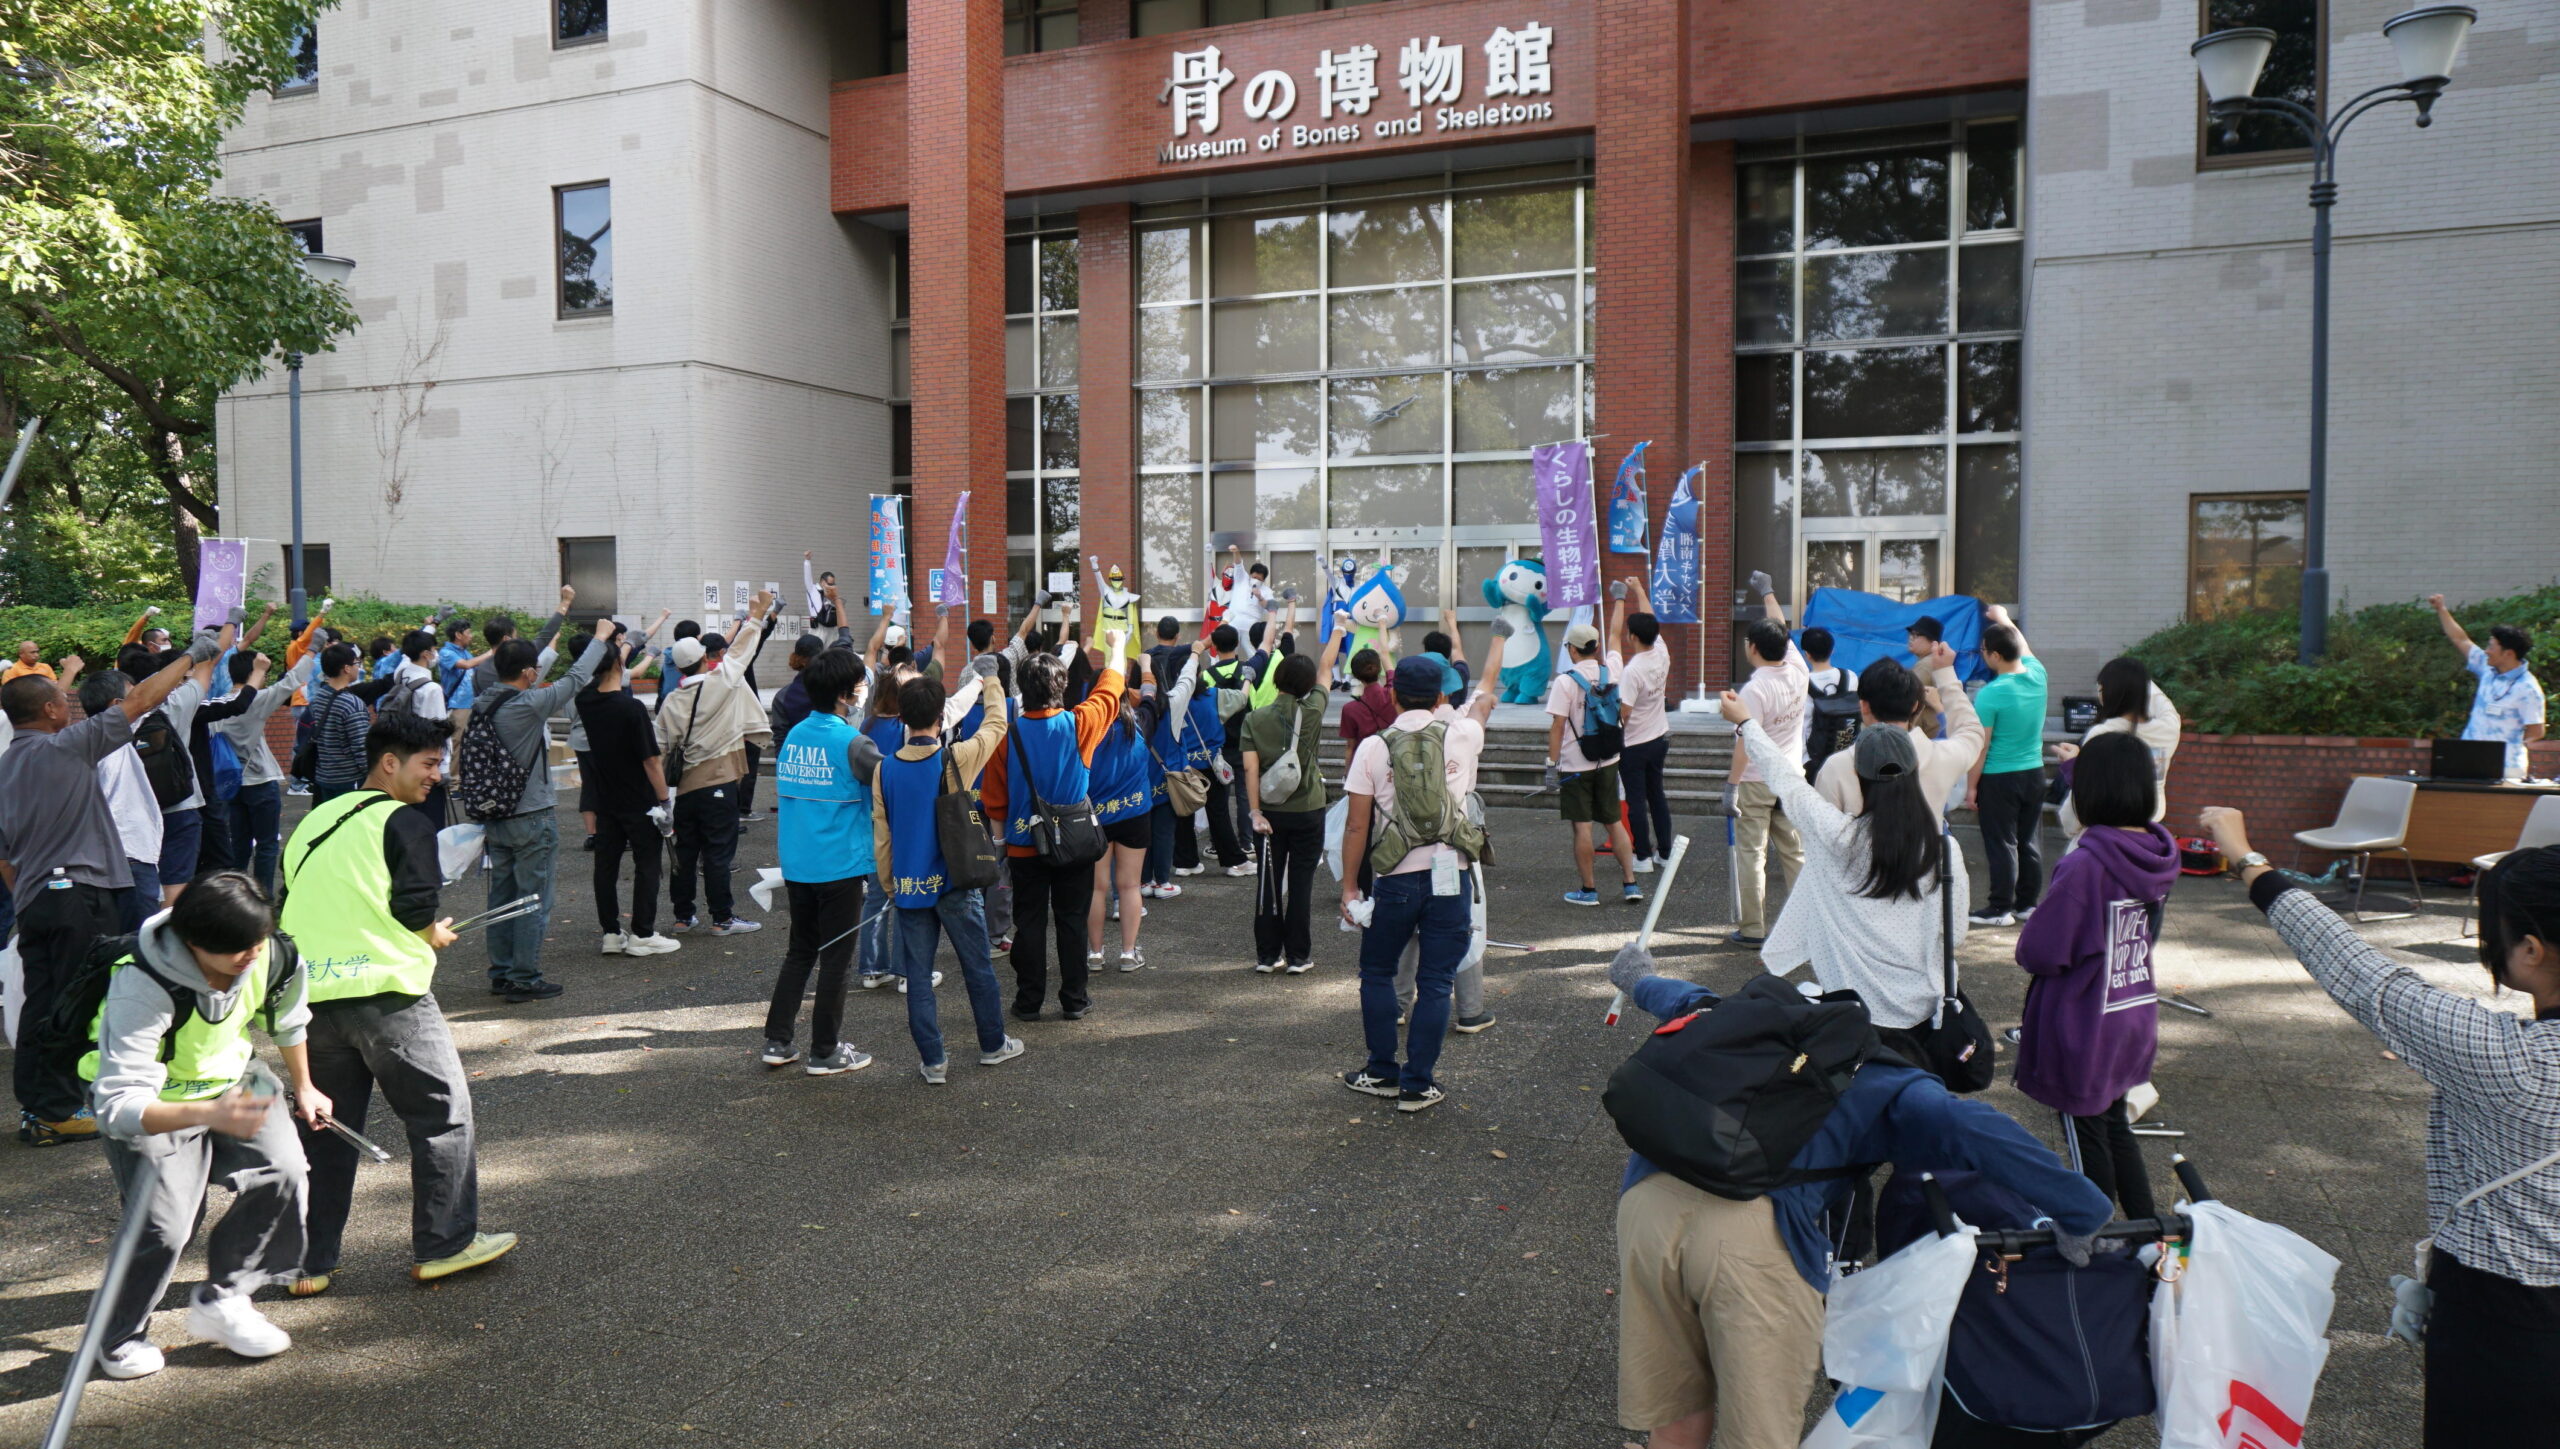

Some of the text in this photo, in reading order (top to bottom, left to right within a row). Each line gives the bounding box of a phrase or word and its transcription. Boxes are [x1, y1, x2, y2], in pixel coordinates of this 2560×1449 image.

[1160, 21, 1553, 137] 骨の博物館
[1156, 99, 1553, 163] Museum of Bones and Skeletons
[1552, 451, 1585, 602] くらしの生物学科
[787, 744, 829, 766] TAMA
[778, 762, 834, 779] UNIVERSITY
[1095, 791, 1144, 815] 多摩大学
[2133, 939, 2149, 968] UP
[2112, 966, 2150, 988] EST 2019
